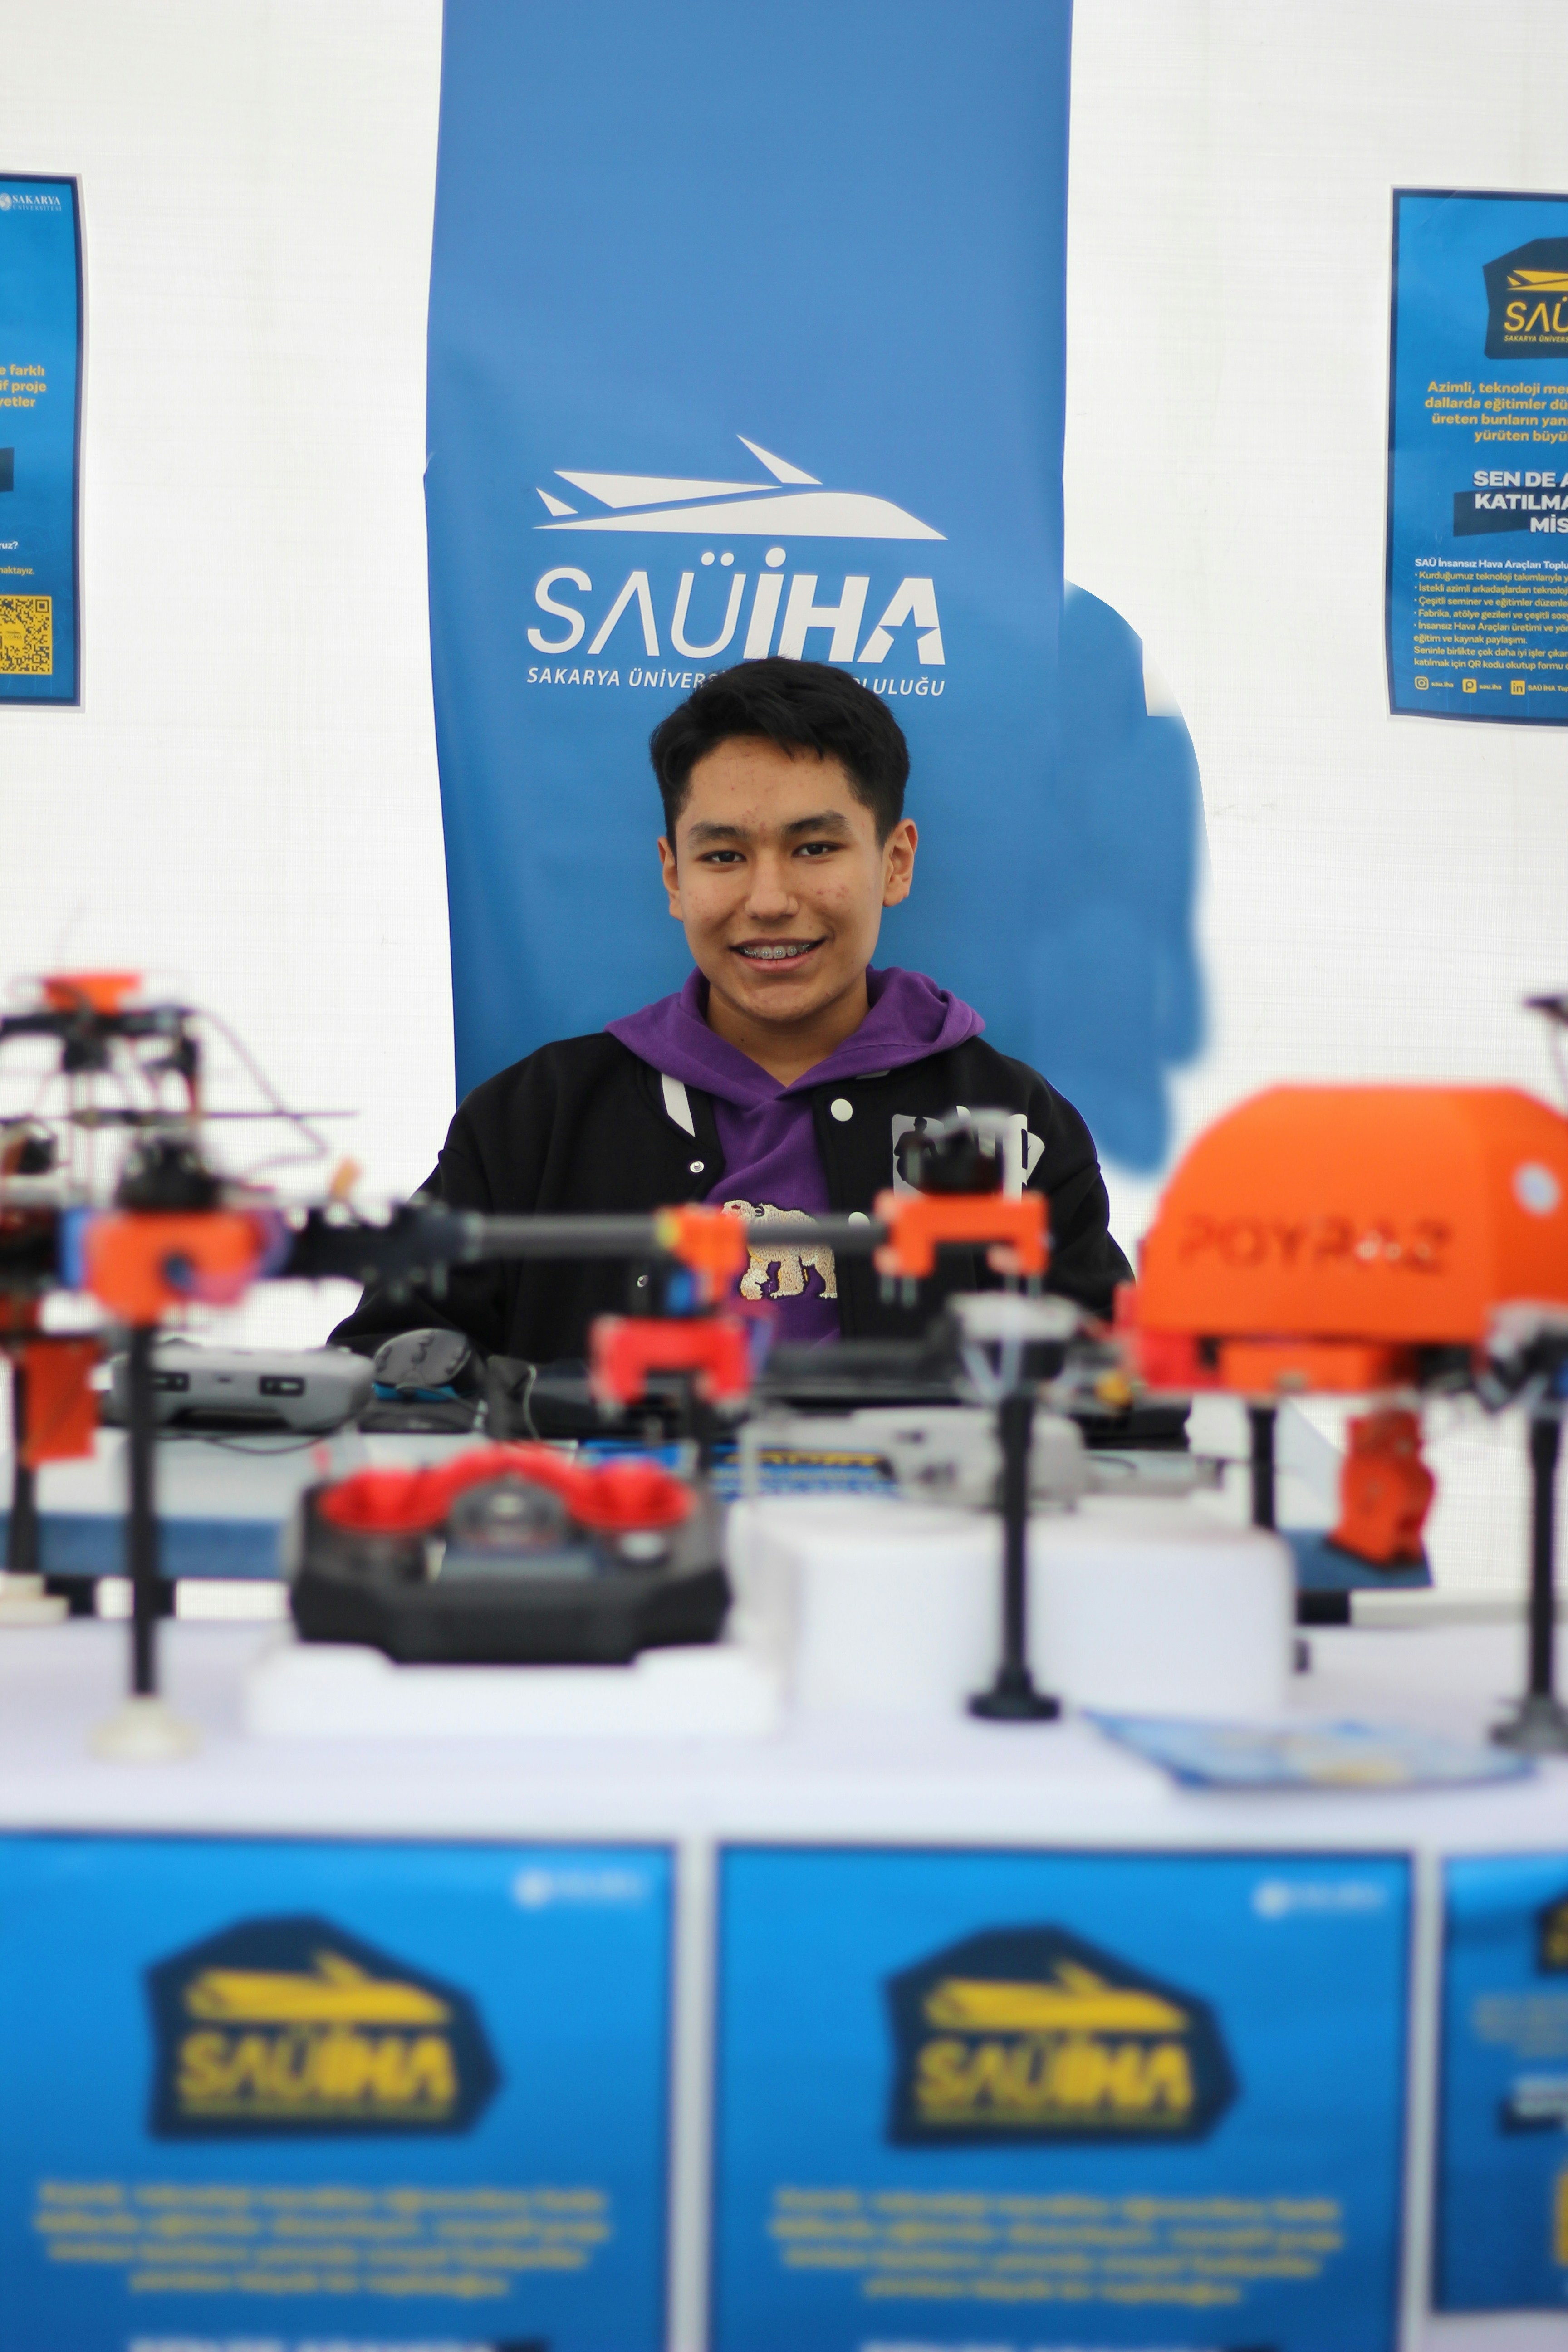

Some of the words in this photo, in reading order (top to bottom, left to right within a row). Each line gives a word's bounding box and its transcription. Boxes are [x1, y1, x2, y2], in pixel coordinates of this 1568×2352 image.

[12, 195, 61, 205] SAKARYA
[10, 363, 45, 376] farklı
[11, 381, 47, 394] proje
[1427, 381, 1475, 394] Azimli,
[1479, 382, 1540, 396] teknoloji
[1425, 397, 1481, 409] dallarda
[1484, 397, 1547, 412] eğitimler
[1432, 413, 1478, 425] üreten
[1481, 413, 1539, 425] bunların
[1475, 430, 1529, 443] yürüten
[1533, 429, 1568, 444] büyü
[1474, 470, 1521, 487] SEN
[1524, 471, 1556, 488] DE
[1415, 557, 1437, 567] SAÜ
[1438, 557, 1477, 568] İnsansız
[1478, 559, 1503, 568] Hava
[1504, 560, 1542, 571] Araçları
[1419, 571, 1474, 582] Kurduğumuz
[1475, 572, 1512, 583] teknoloji
[1419, 582, 1445, 592] İstekli
[1446, 584, 1471, 593] azimli
[1472, 585, 1531, 595] arkadaşlardan
[527, 547, 946, 665] SAÜİHA
[1419, 596, 1446, 607] Çeşitli
[1448, 598, 1482, 606] seminer
[1495, 598, 1533, 608] eğitimler
[1418, 608, 1451, 618] Fabrika,
[1453, 610, 1480, 620] atölye
[1481, 611, 1511, 620] gezileri
[1524, 612, 1550, 621] çeşitli
[1418, 620, 1452, 630] İnsansız
[1454, 622, 1476, 631] Hava
[1477, 622, 1510, 632] Araçları
[1511, 623, 1542, 632] üretimi
[1413, 634, 1441, 644] eğitim
[1454, 635, 1484, 645] kaynak
[1414, 646, 1445, 654] Seninle
[1447, 647, 1475, 656] birlikte
[1477, 647, 1494, 657] çok
[1494, 647, 1516, 657] daha
[1529, 648, 1546, 658] işler
[1414, 658, 1450, 667] katılmak
[1451, 660, 1466, 669] için
[1467, 660, 1481, 669] QR
[1482, 660, 1504, 669] kodu
[1505, 661, 1536, 671] okutup
[1538, 661, 1563, 670] formu
[527, 667, 620, 686] SAKARYA
